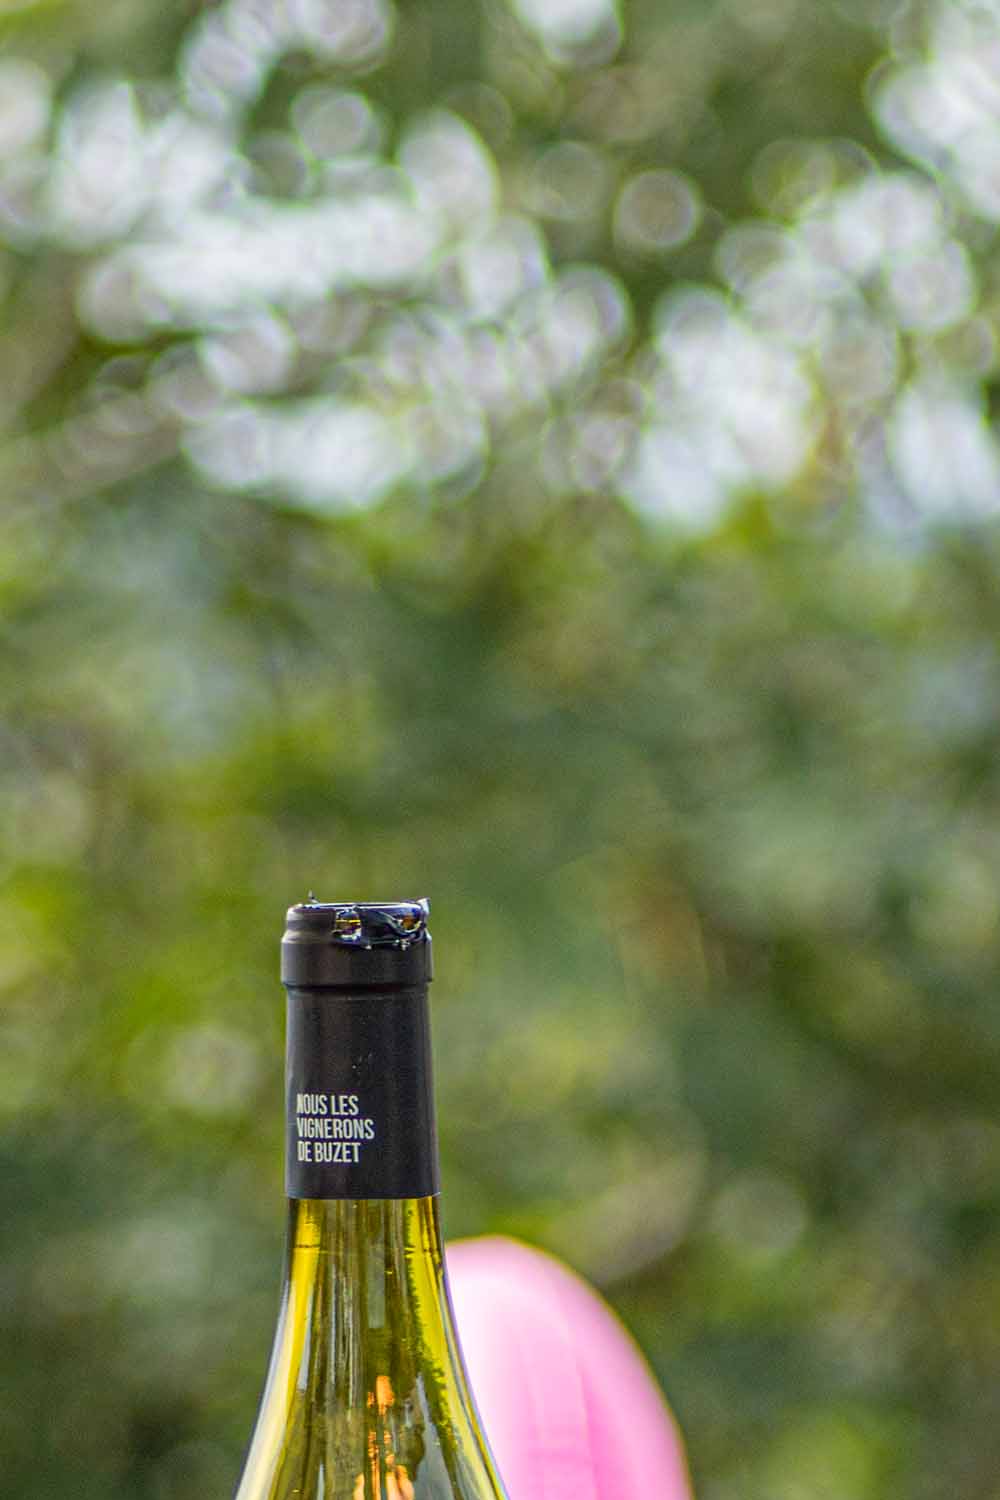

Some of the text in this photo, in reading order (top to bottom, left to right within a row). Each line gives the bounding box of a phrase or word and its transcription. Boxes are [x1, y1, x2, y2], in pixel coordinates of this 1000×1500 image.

[296, 1093, 359, 1116] NOUS LES
[296, 1117, 375, 1139] VIGNERONS
[297, 1141, 361, 1163] DE BUZET
